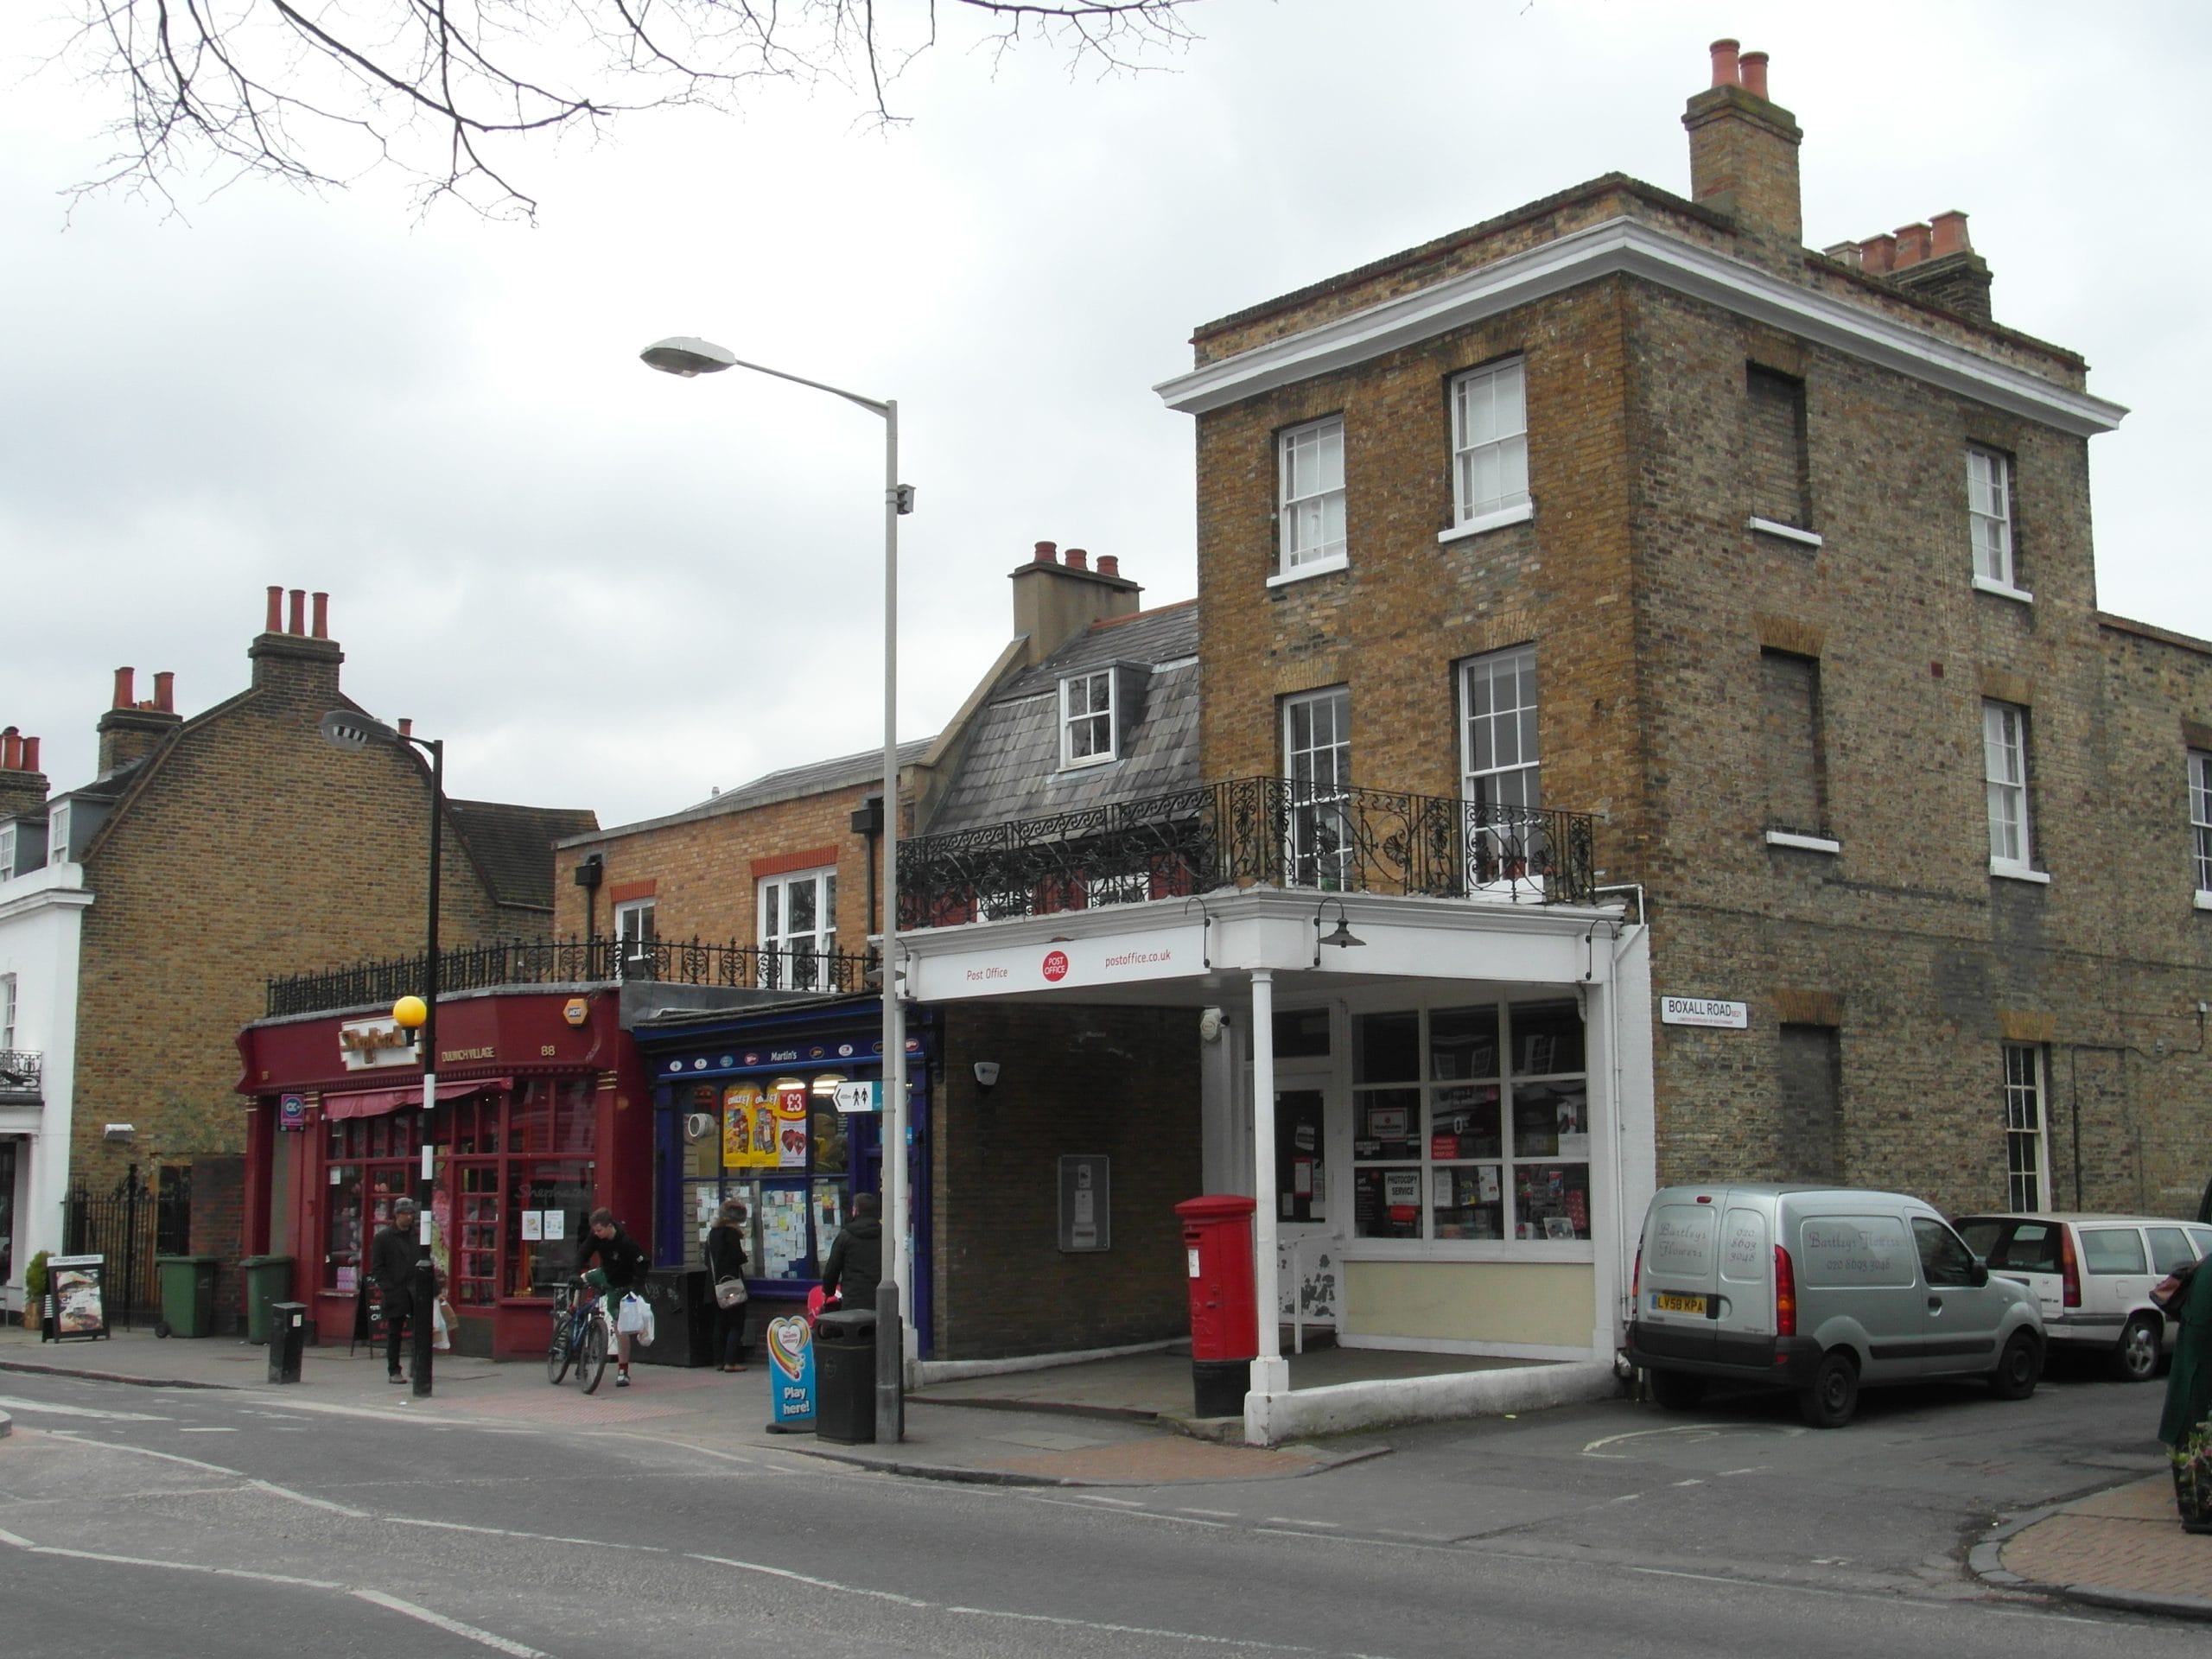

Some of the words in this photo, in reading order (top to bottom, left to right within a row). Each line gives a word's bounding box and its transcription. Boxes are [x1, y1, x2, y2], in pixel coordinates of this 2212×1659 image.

[1048, 957, 1064, 965] POST
[1105, 950, 1171, 969] postoffice.co.uk
[966, 970, 983, 981] Post
[985, 968, 1008, 979] Office
[1045, 965, 1065, 975] OFFICE
[1669, 1000, 1705, 1015] BOXALL
[1707, 1002, 1732, 1016] ROAD
[442, 1049, 468, 1062] DULWICH
[468, 1046, 495, 1059] VILLAGE
[541, 1046, 556, 1056] 88
[771, 1051, 798, 1061] Martin's
[786, 1093, 803, 1112] £3
[1387, 1175, 1417, 1184] PHOTOCOPY
[1392, 1186, 1414, 1196] SERVICE
[1736, 1229, 1755, 1237] 020
[1659, 1241, 1702, 1257] Flowers
[1827, 1261, 1842, 1270] 020
[1657, 1294, 1682, 1310] LV58
[784, 1387, 806, 1400] Play
[783, 1401, 810, 1415] here!
